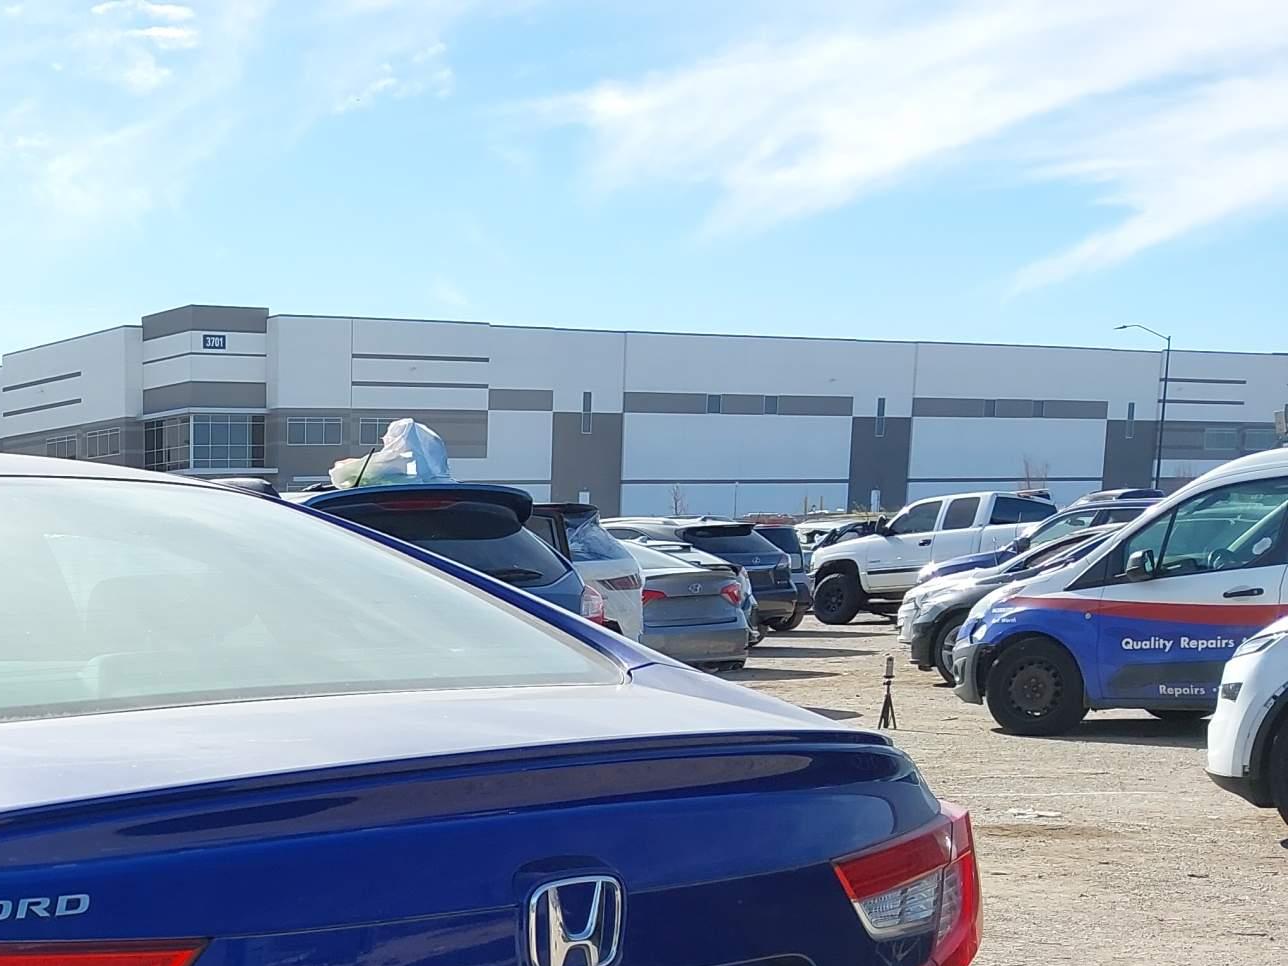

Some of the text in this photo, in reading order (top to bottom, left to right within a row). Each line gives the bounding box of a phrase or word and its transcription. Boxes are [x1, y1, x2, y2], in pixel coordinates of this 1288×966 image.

[206, 336, 224, 348] 3701
[1121, 636, 1235, 652] Quality Repairs
[1159, 685, 1206, 697] Repairs
